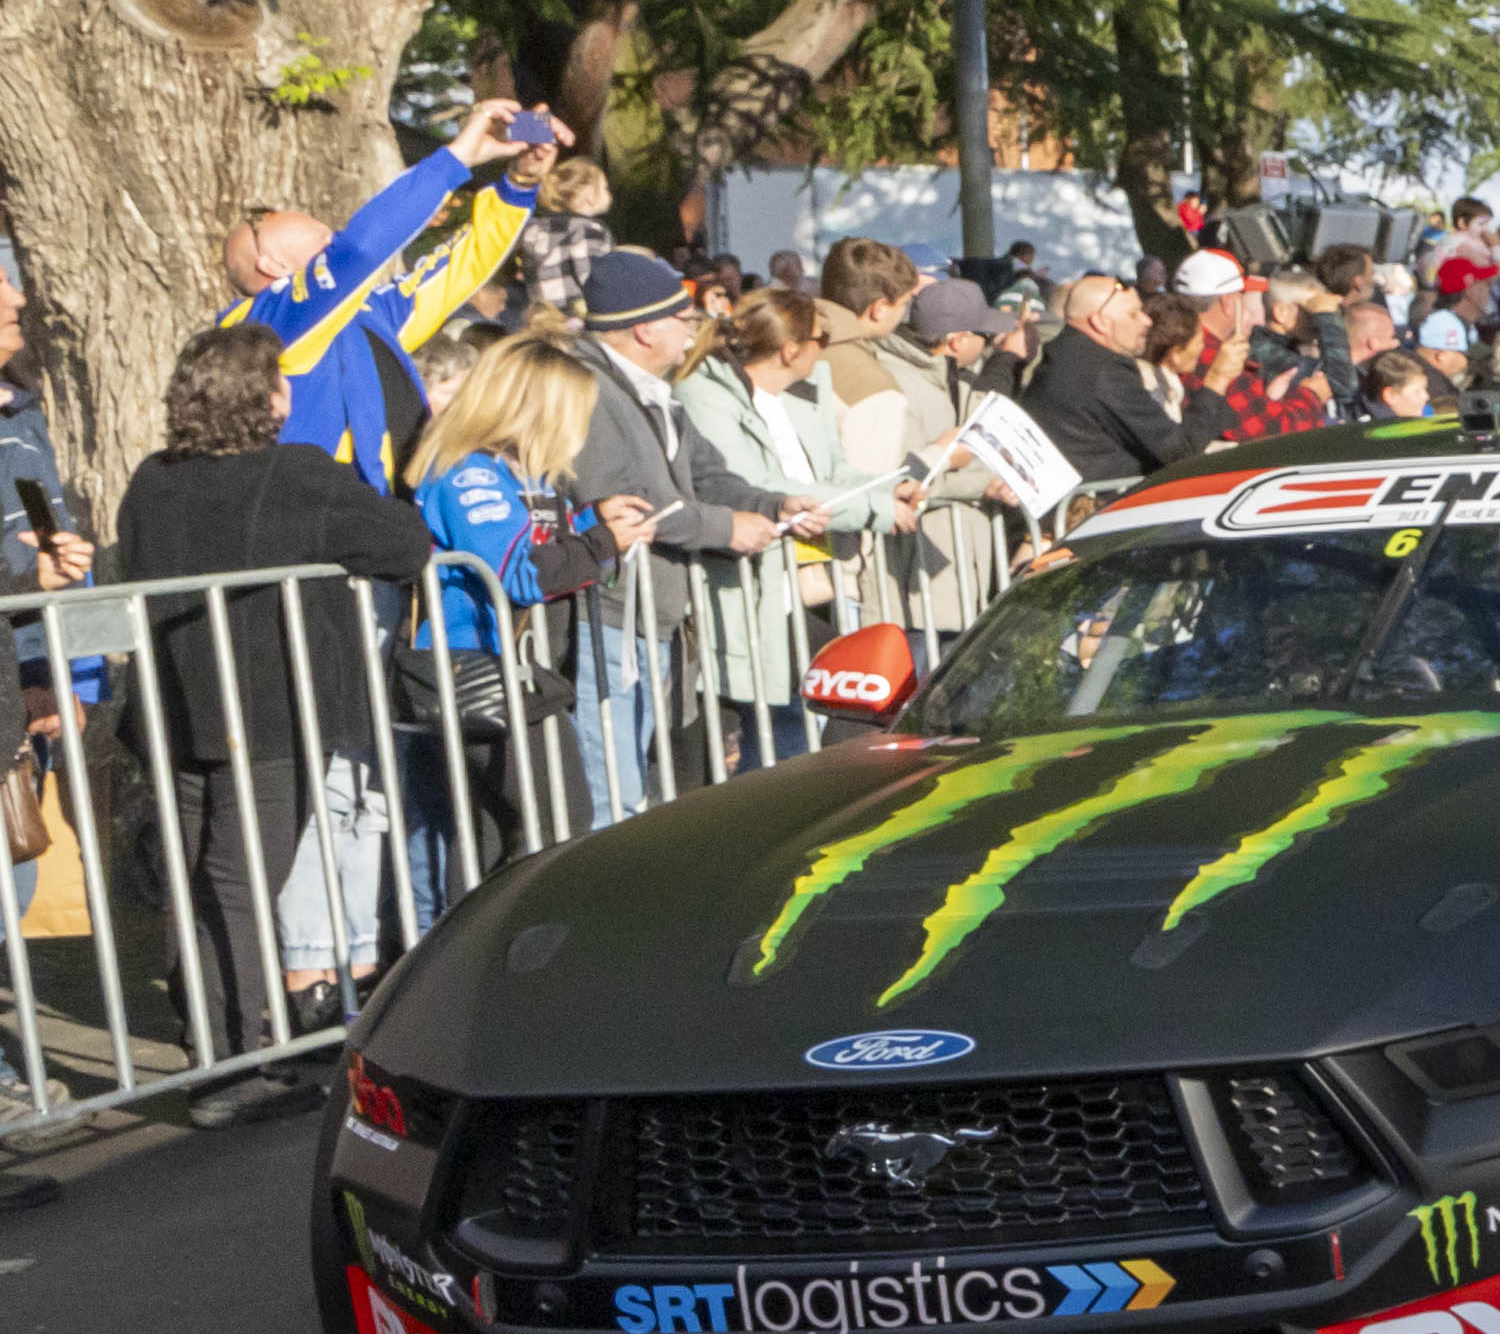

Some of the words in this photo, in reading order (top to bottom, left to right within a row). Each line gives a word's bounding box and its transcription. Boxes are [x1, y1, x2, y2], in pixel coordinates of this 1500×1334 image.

[1384, 529, 1423, 559] 6
[802, 668, 892, 703] RYCO
[834, 1034, 946, 1067] Ford
